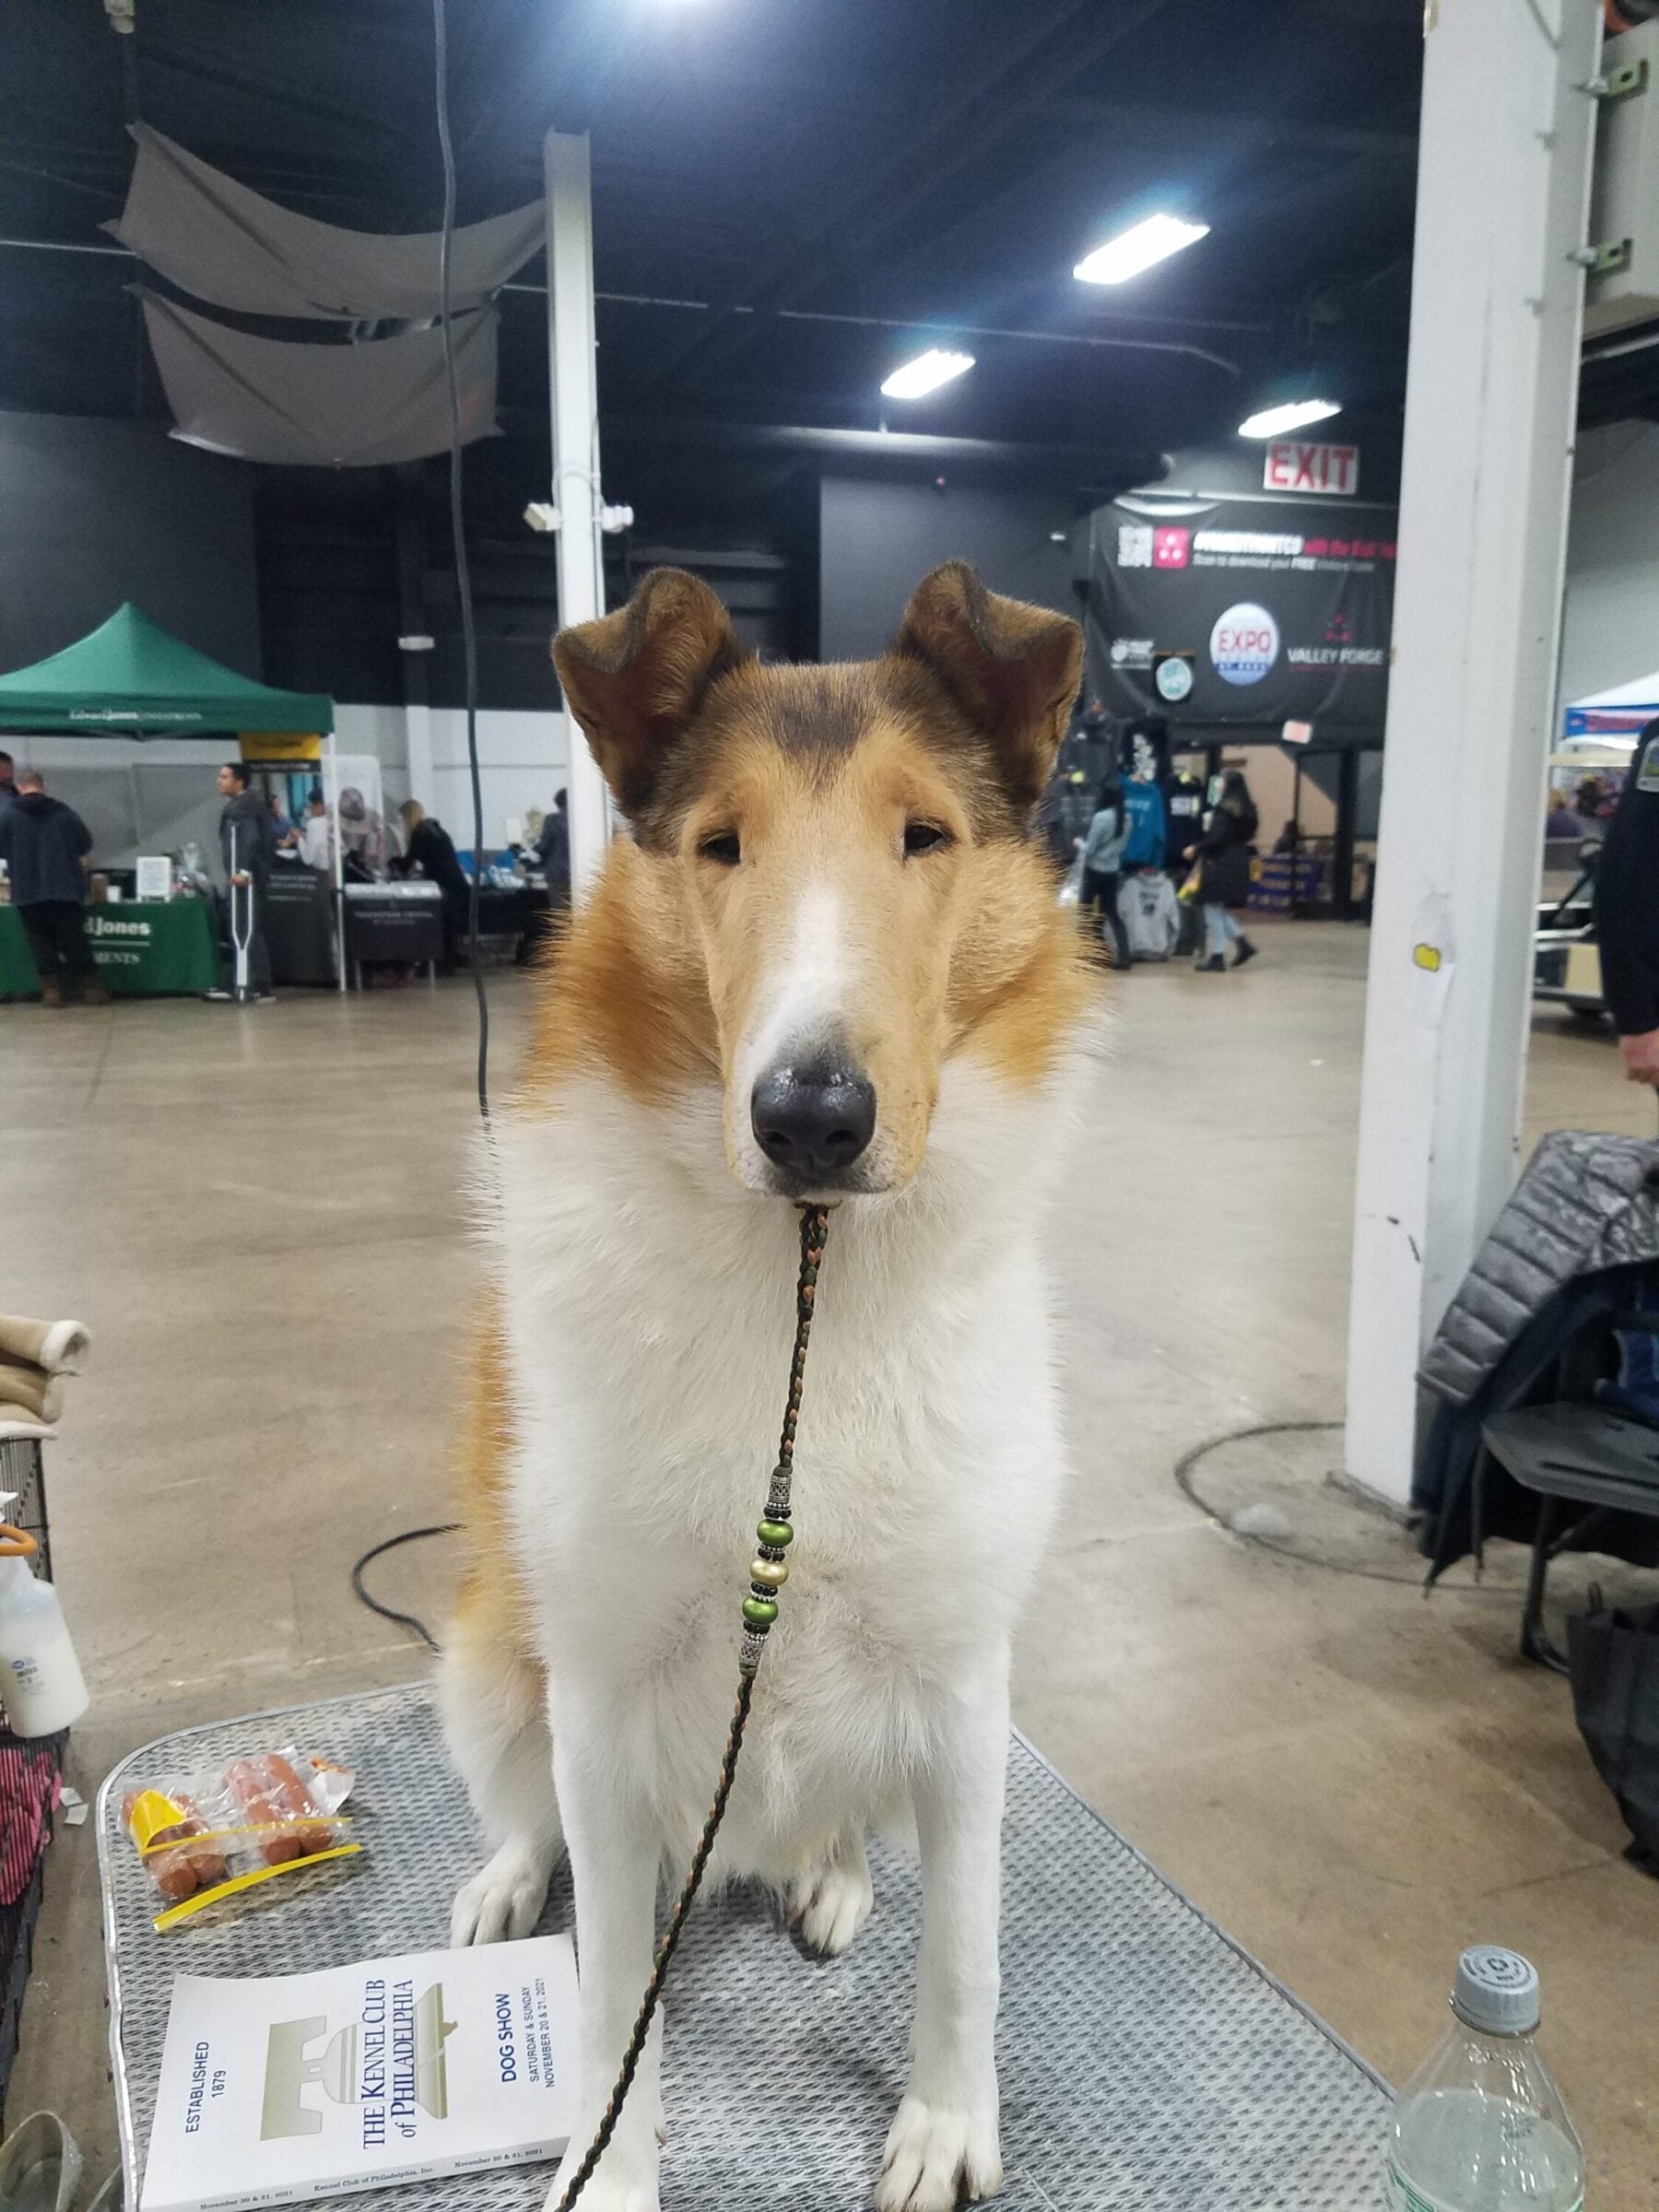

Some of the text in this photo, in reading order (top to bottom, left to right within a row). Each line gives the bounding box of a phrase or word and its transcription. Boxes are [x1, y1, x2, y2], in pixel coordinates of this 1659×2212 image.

[1268, 443, 1355, 491] EXIT
[1218, 629, 1270, 653] EXPO
[1287, 647, 1384, 665] VALLEY FORGE
[521, 1986, 534, 2021] SUNDAY
[535, 1977, 546, 1996] 2021
[495, 1994, 516, 2083] DOG SHOW
[539, 2020, 549, 2031] 20
[360, 1980, 385, 2149] THE KENNEL CLUB
[391, 1980, 418, 2138] of PHILADELPHIA
[524, 2032, 540, 2083] SATURDAY
[540, 2032, 555, 2088] NOVEMBER
[185, 2041, 210, 2134] ESTABLISHED
[211, 2070, 227, 2099] 1879
[200, 2198, 238, 2211] November
[275, 2190, 293, 2198] 2021
[314, 2181, 341, 2192] Kennel
[342, 2176, 359, 2187] Club
[361, 2175, 370, 2184] of
[454, 2156, 491, 2168] November
